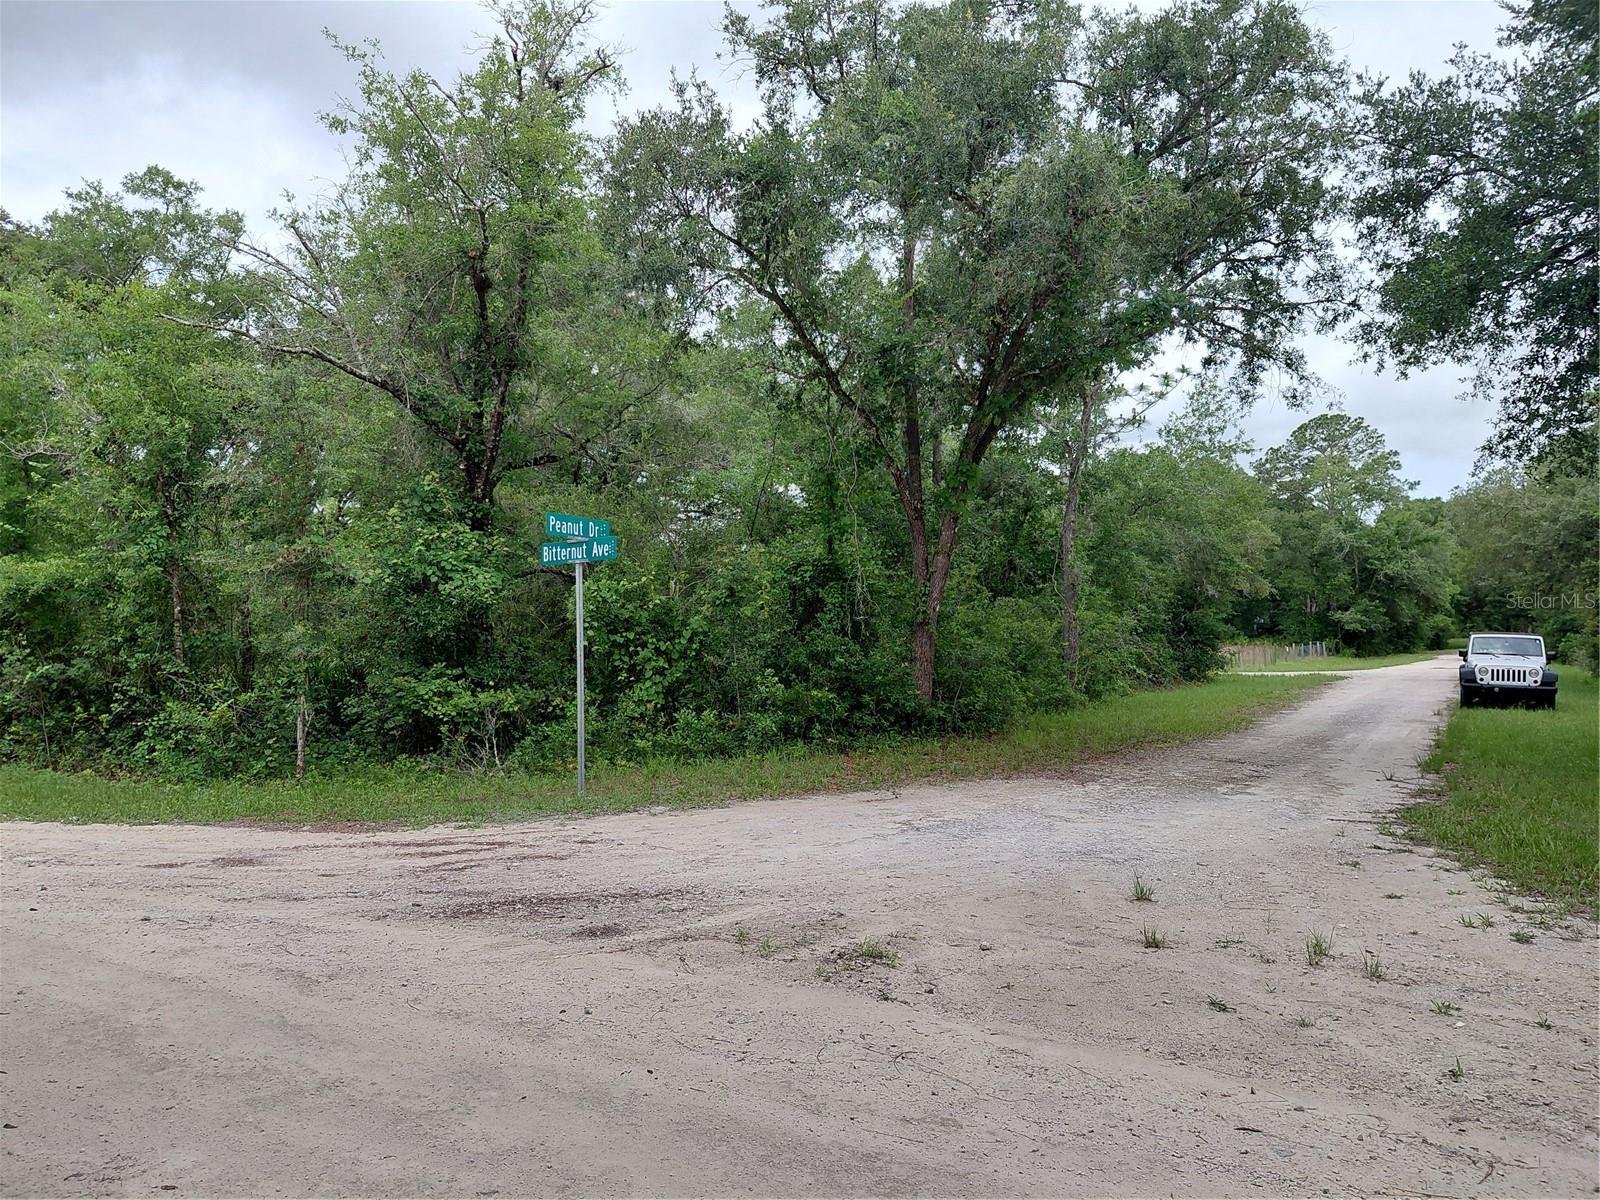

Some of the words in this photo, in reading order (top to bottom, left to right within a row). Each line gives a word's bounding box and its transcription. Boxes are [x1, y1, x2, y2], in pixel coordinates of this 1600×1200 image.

[549, 515, 584, 536] Peanut
[588, 521, 599, 538] Dr
[543, 543, 587, 562] Bitternut
[592, 541, 609, 557] Ave
